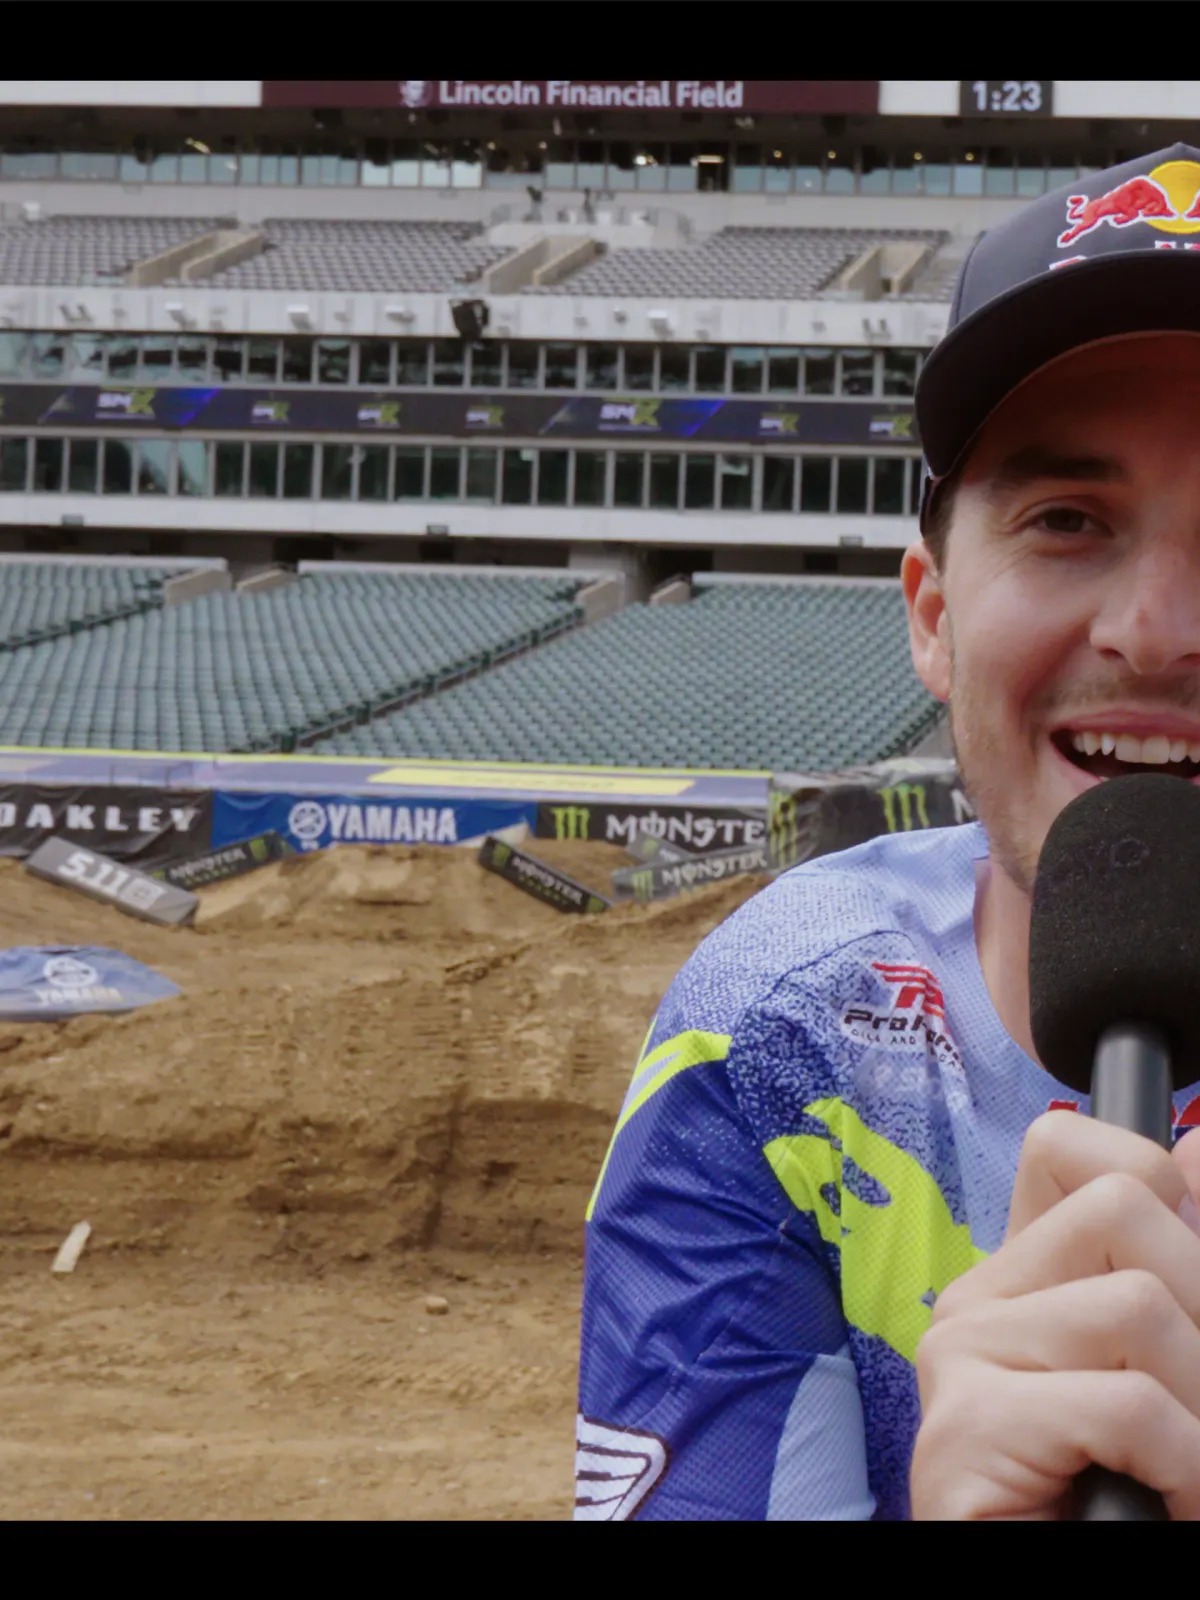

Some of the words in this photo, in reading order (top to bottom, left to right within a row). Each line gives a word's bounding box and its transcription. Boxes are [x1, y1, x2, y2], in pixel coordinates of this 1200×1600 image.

[440, 81, 540, 105] Lincoln
[547, 81, 670, 106] Financial
[677, 82, 743, 107] Field
[972, 81, 1042, 111] 1:23
[328, 805, 457, 841] YAMAHA
[605, 810, 767, 848] MONSTE
[660, 850, 768, 887] MONSTER
[890, 1035, 917, 1045] AND
